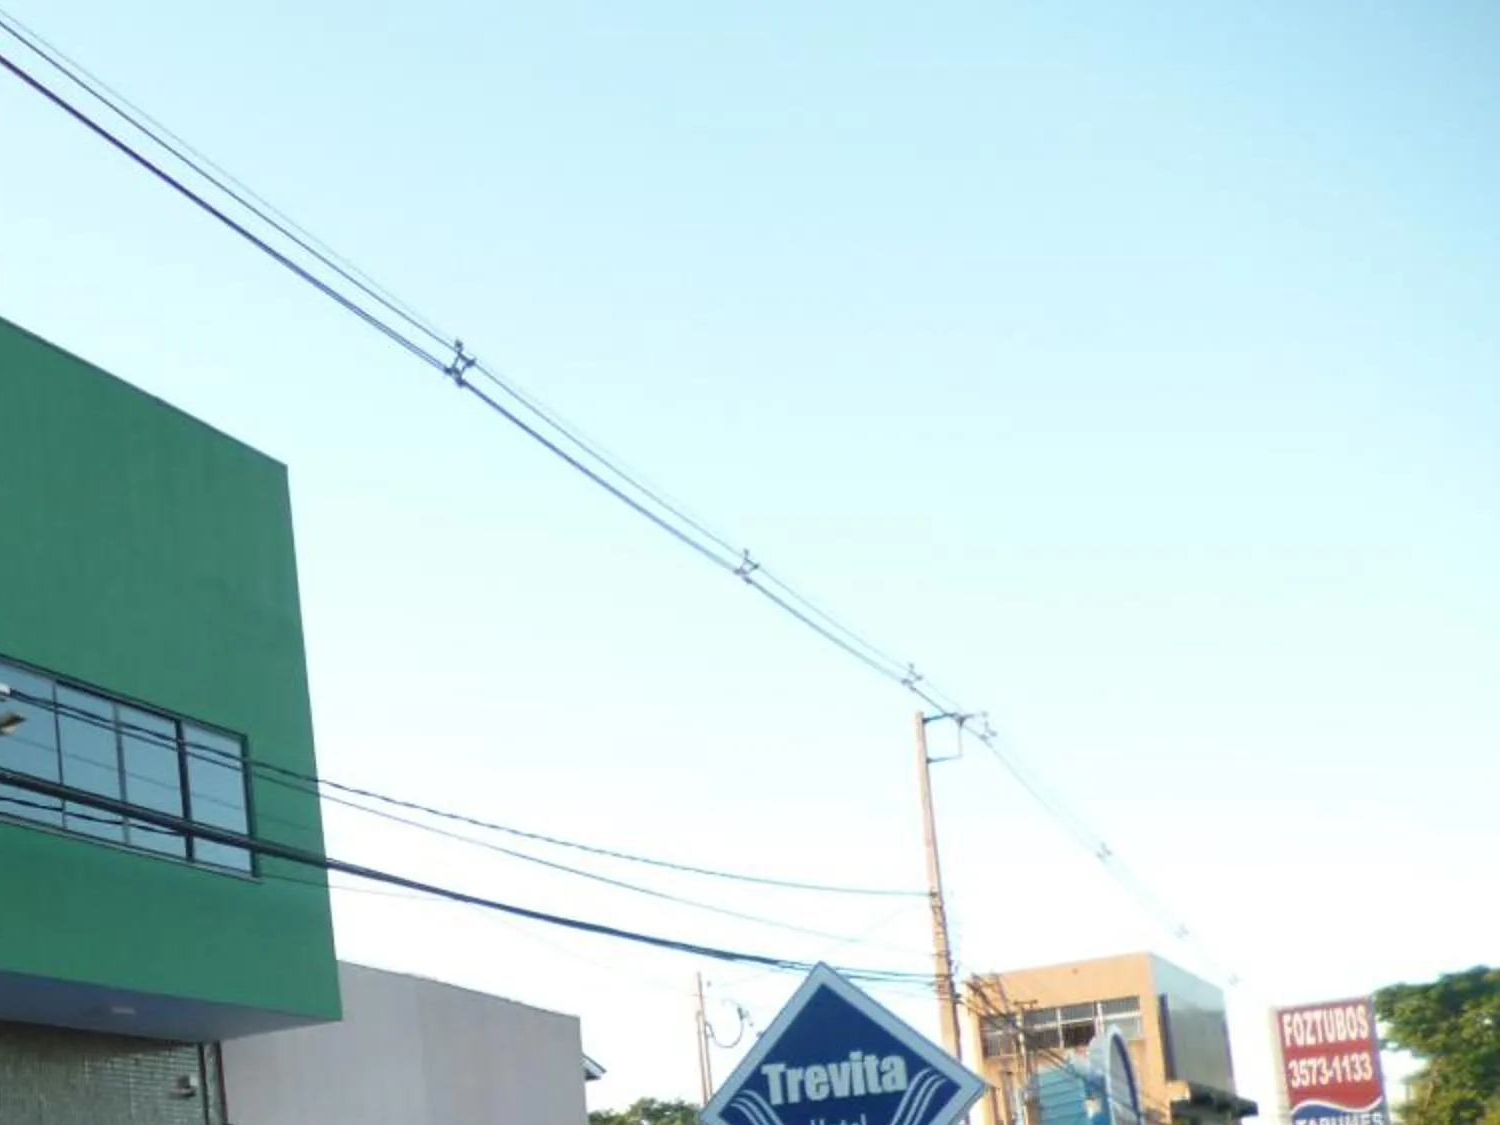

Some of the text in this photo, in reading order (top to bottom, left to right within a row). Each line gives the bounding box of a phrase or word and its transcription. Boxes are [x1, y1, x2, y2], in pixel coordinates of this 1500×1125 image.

[1283, 1006, 1368, 1047] FOZTUBOS
[762, 1051, 908, 1106] Trevita
[1288, 1053, 1372, 1087] 3573-1133
